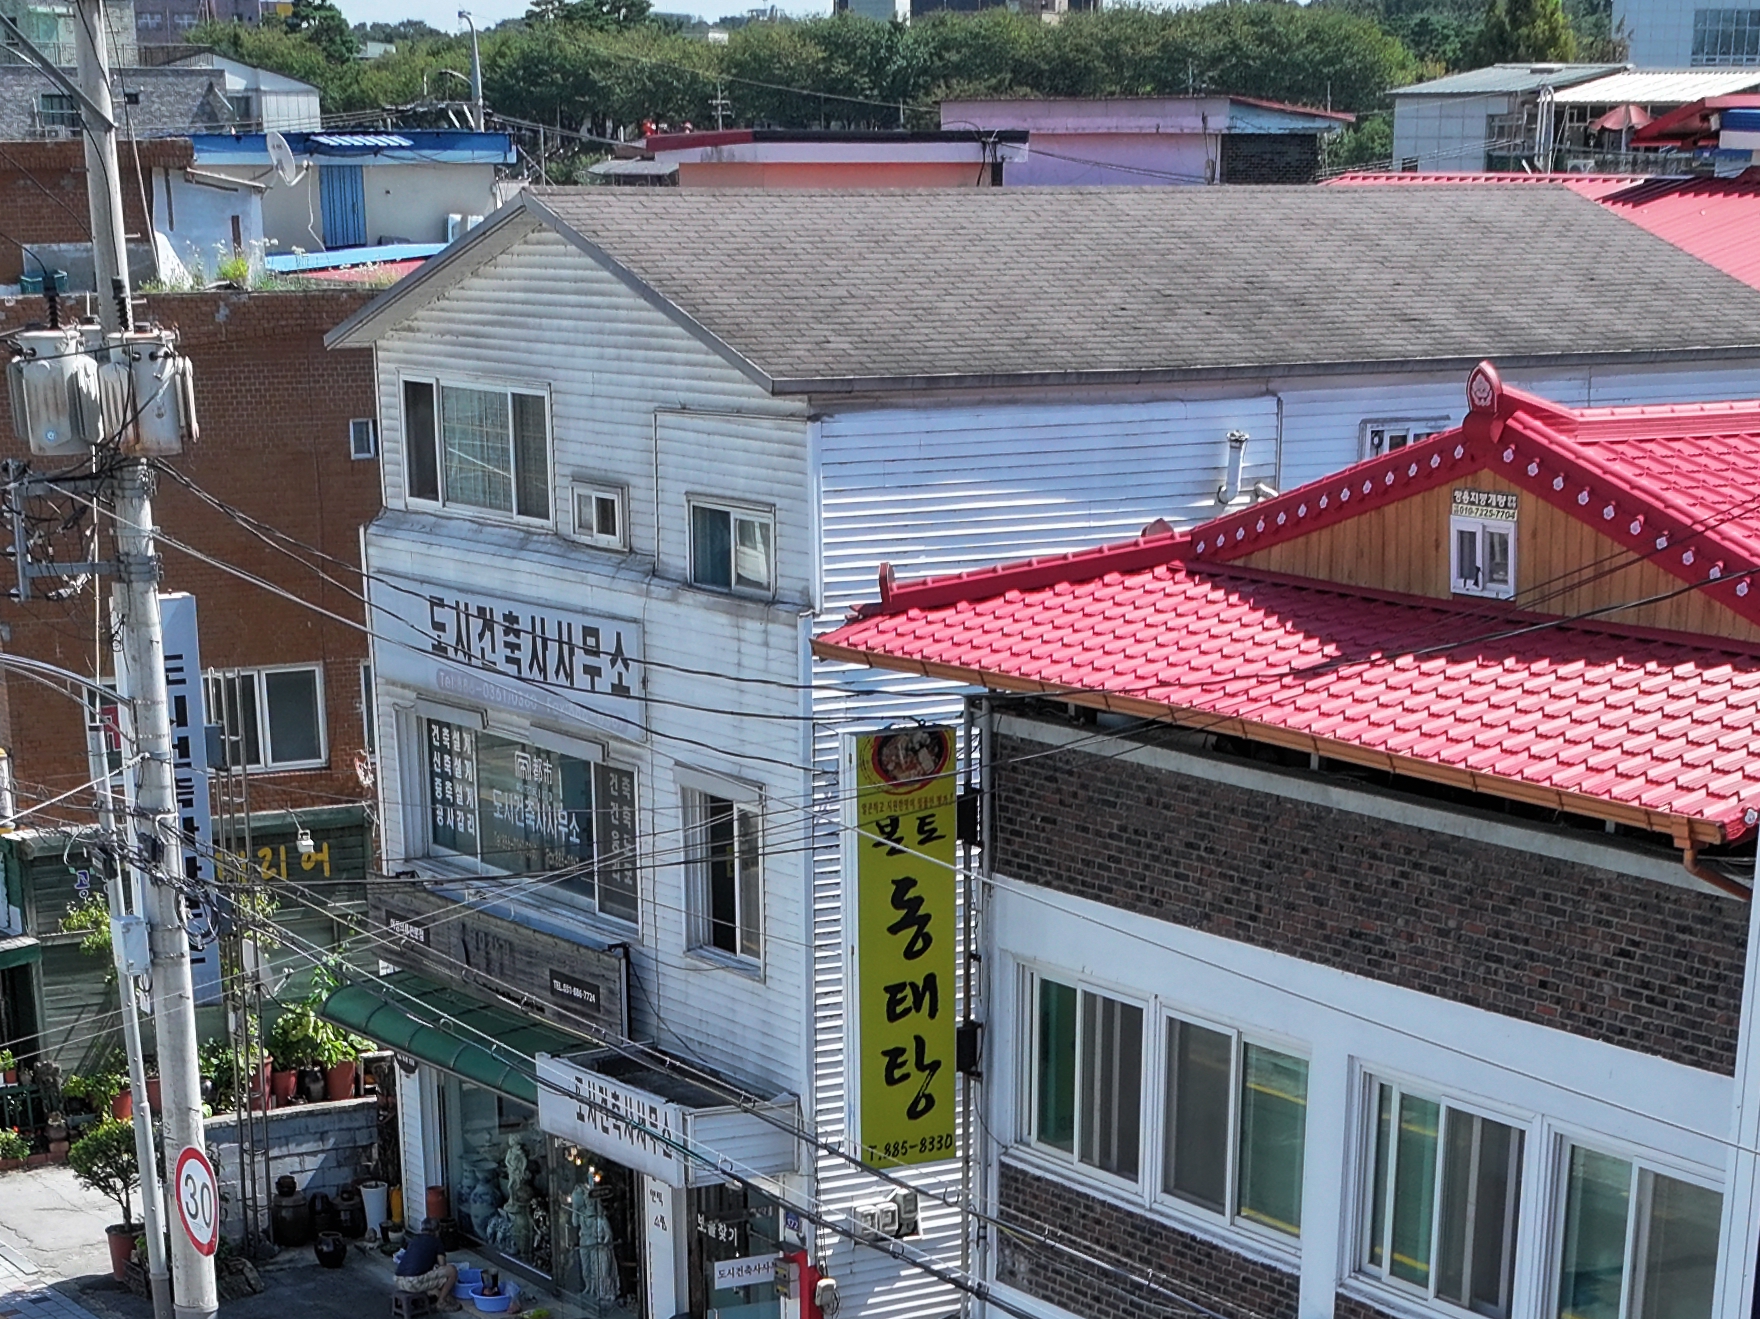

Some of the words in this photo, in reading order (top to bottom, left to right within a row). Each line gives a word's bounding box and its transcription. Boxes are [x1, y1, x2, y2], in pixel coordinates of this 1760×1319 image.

[428, 595, 632, 696] 도시건축사사무소
[493, 789, 581, 845] 도시건축사사무소
[872, 812, 946, 858] 본토
[880, 875, 943, 1121] 동태탕
[574, 1076, 673, 1160] 도시건축사사무소
[183, 1172, 213, 1230] 30
